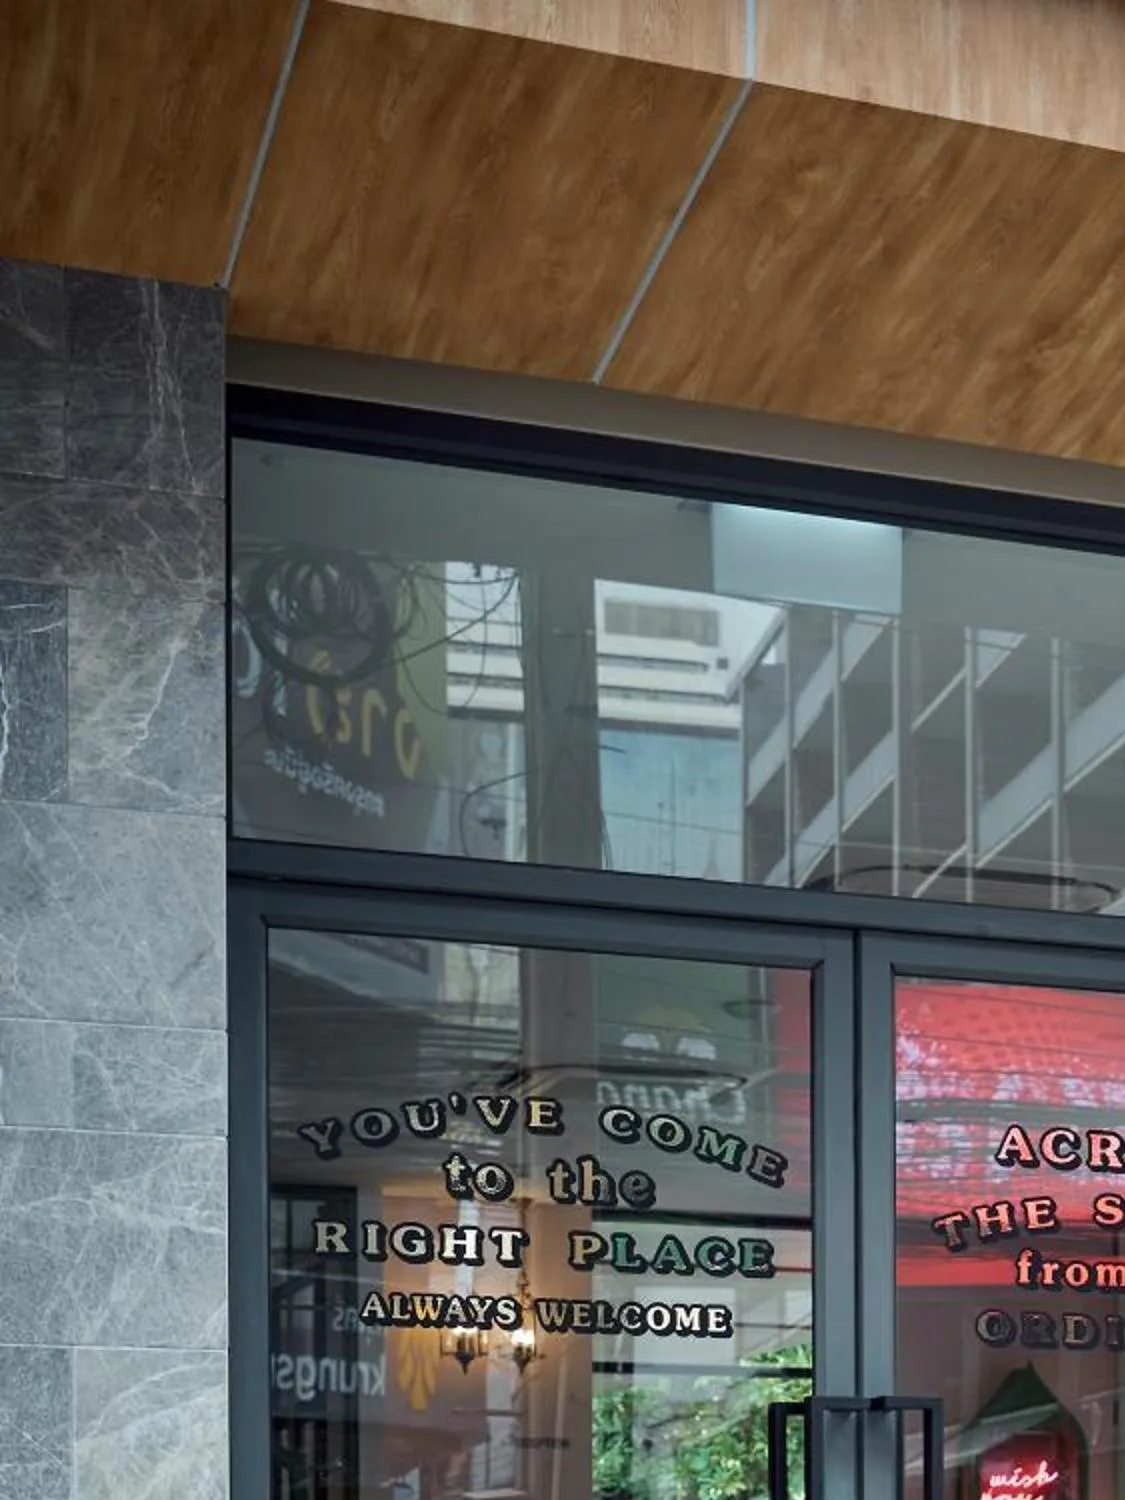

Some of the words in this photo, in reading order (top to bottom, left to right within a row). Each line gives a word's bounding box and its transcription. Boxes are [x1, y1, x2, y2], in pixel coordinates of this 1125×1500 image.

[299, 1093, 564, 1159] YOU'VE
[599, 1104, 788, 1188] COME
[443, 1153, 514, 1201] to
[547, 1154, 656, 1207] the
[313, 1219, 530, 1267] RIGHT
[569, 1229, 776, 1279] PLACE
[933, 1196, 1059, 1251] THE
[360, 1291, 522, 1331] ALWAYS
[535, 1298, 733, 1337] WELCOME
[989, 1460, 1058, 1488] wish
